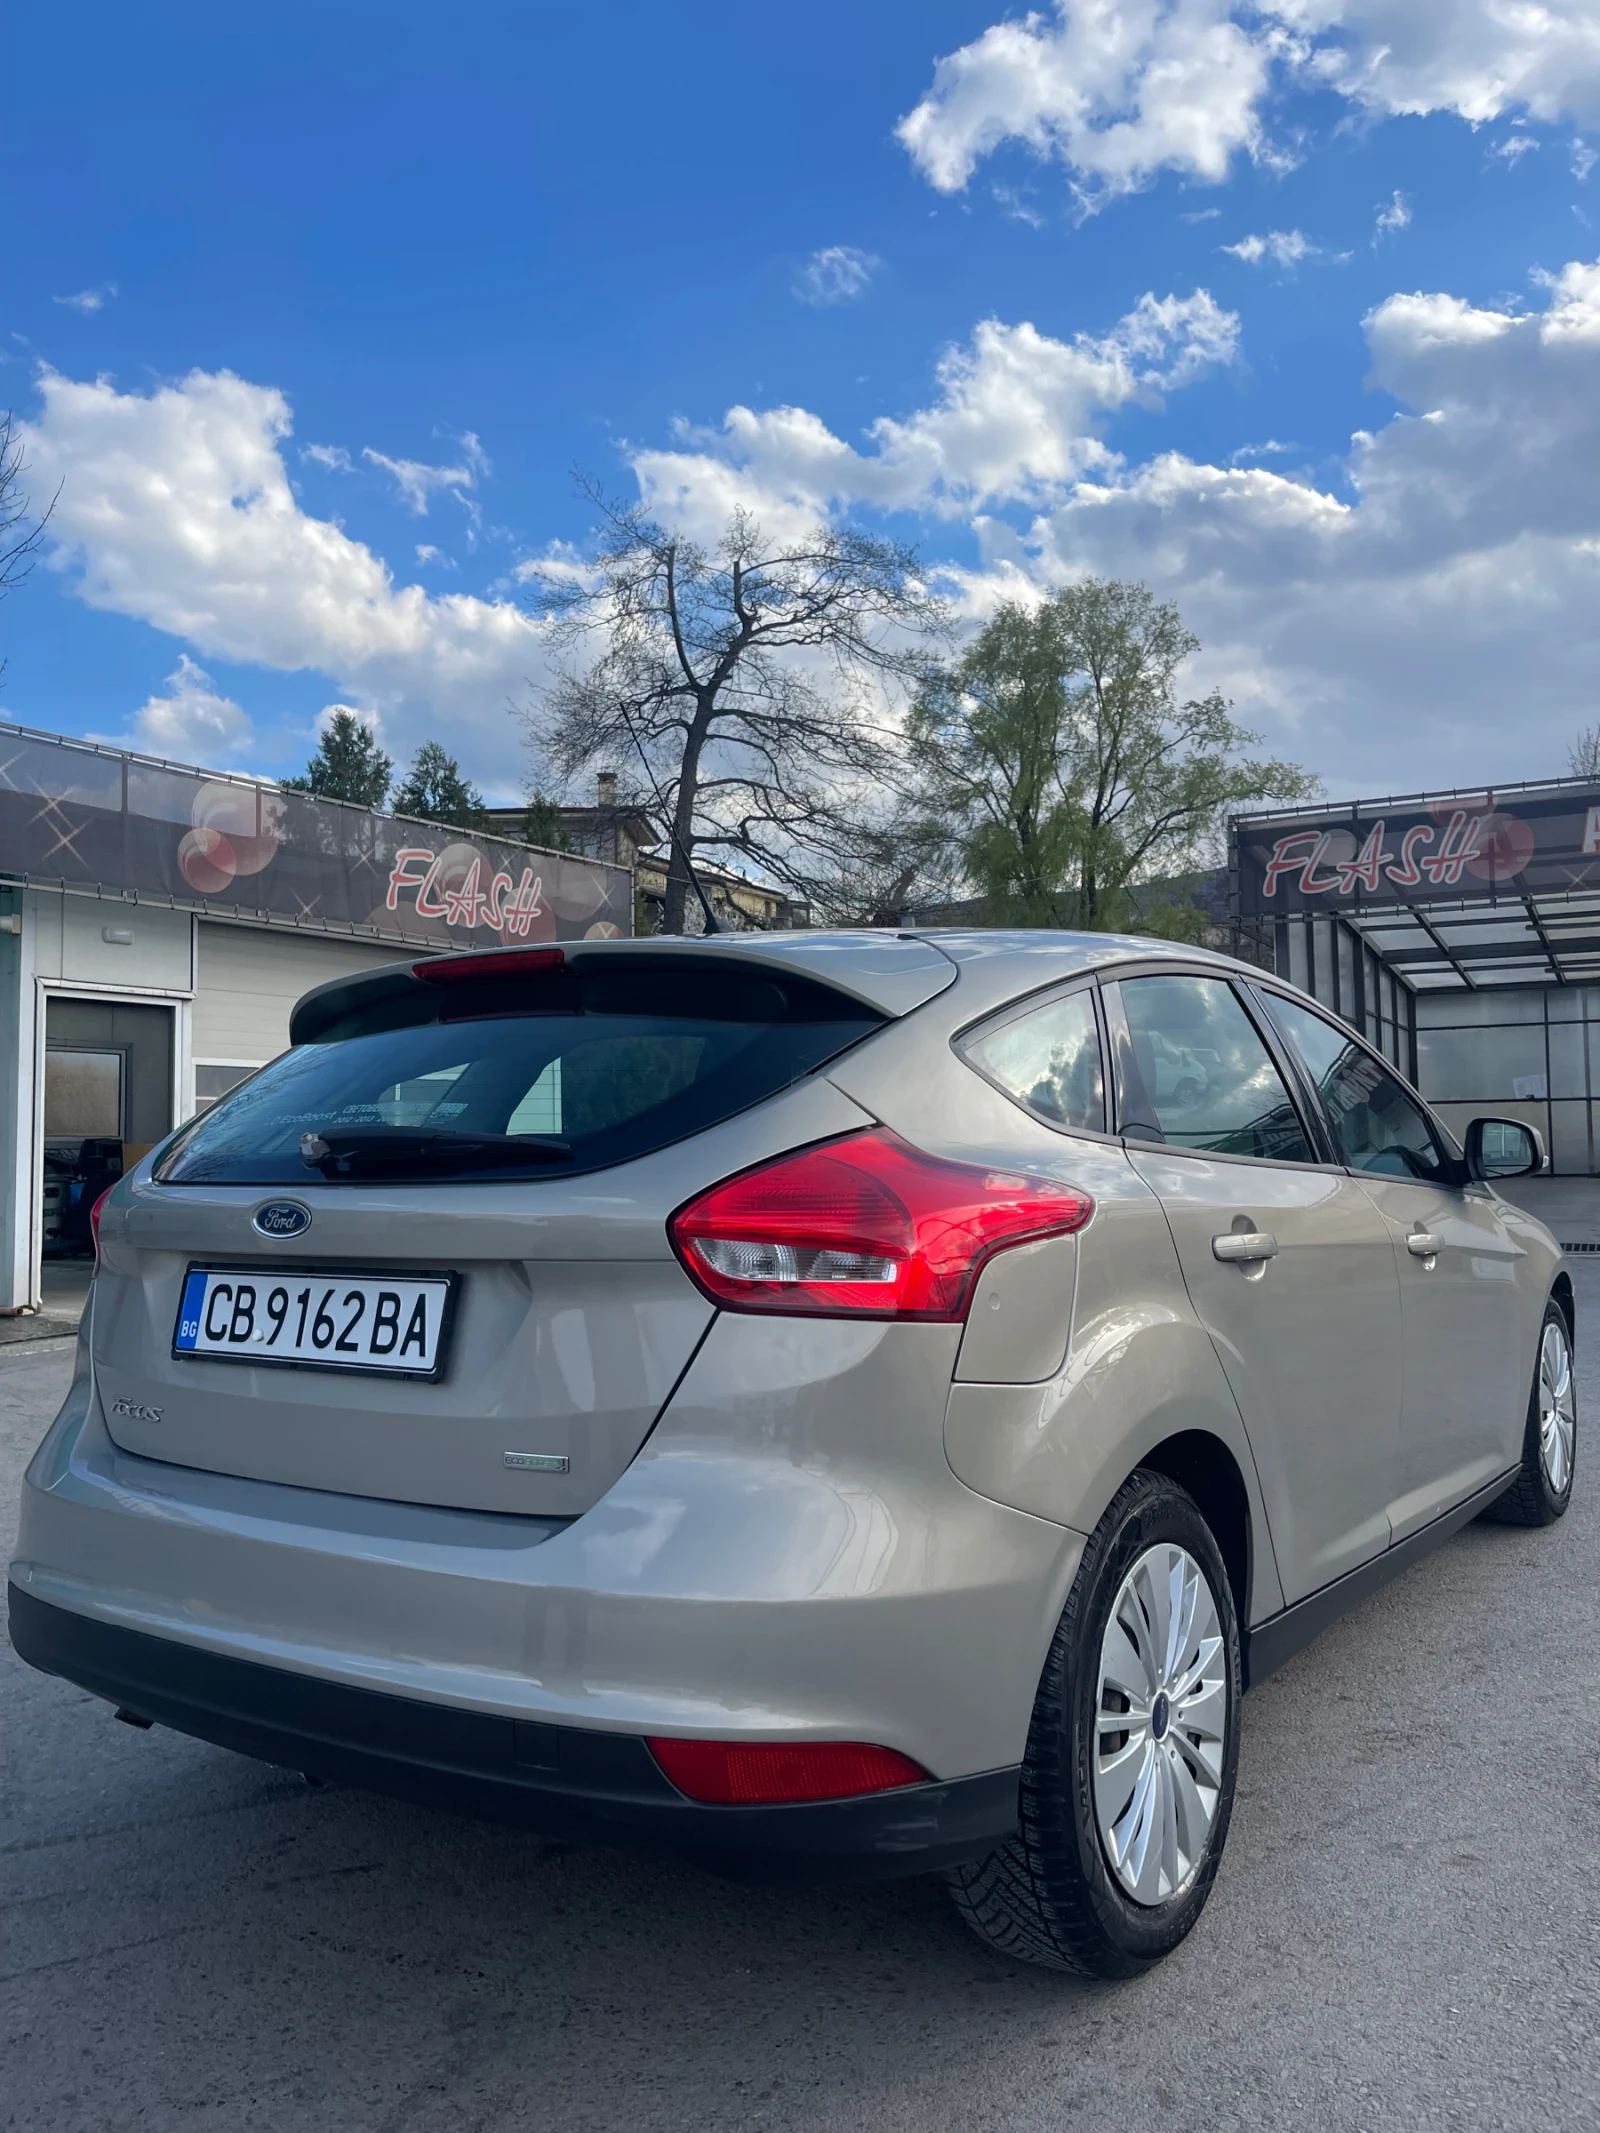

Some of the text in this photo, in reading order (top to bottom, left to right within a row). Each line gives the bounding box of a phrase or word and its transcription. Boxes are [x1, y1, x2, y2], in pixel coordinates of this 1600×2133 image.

[1262, 810, 1481, 897] FLASH
[386, 848, 542, 936] FLASH
[265, 1208, 297, 1228] Ford
[181, 1320, 198, 1339] BG
